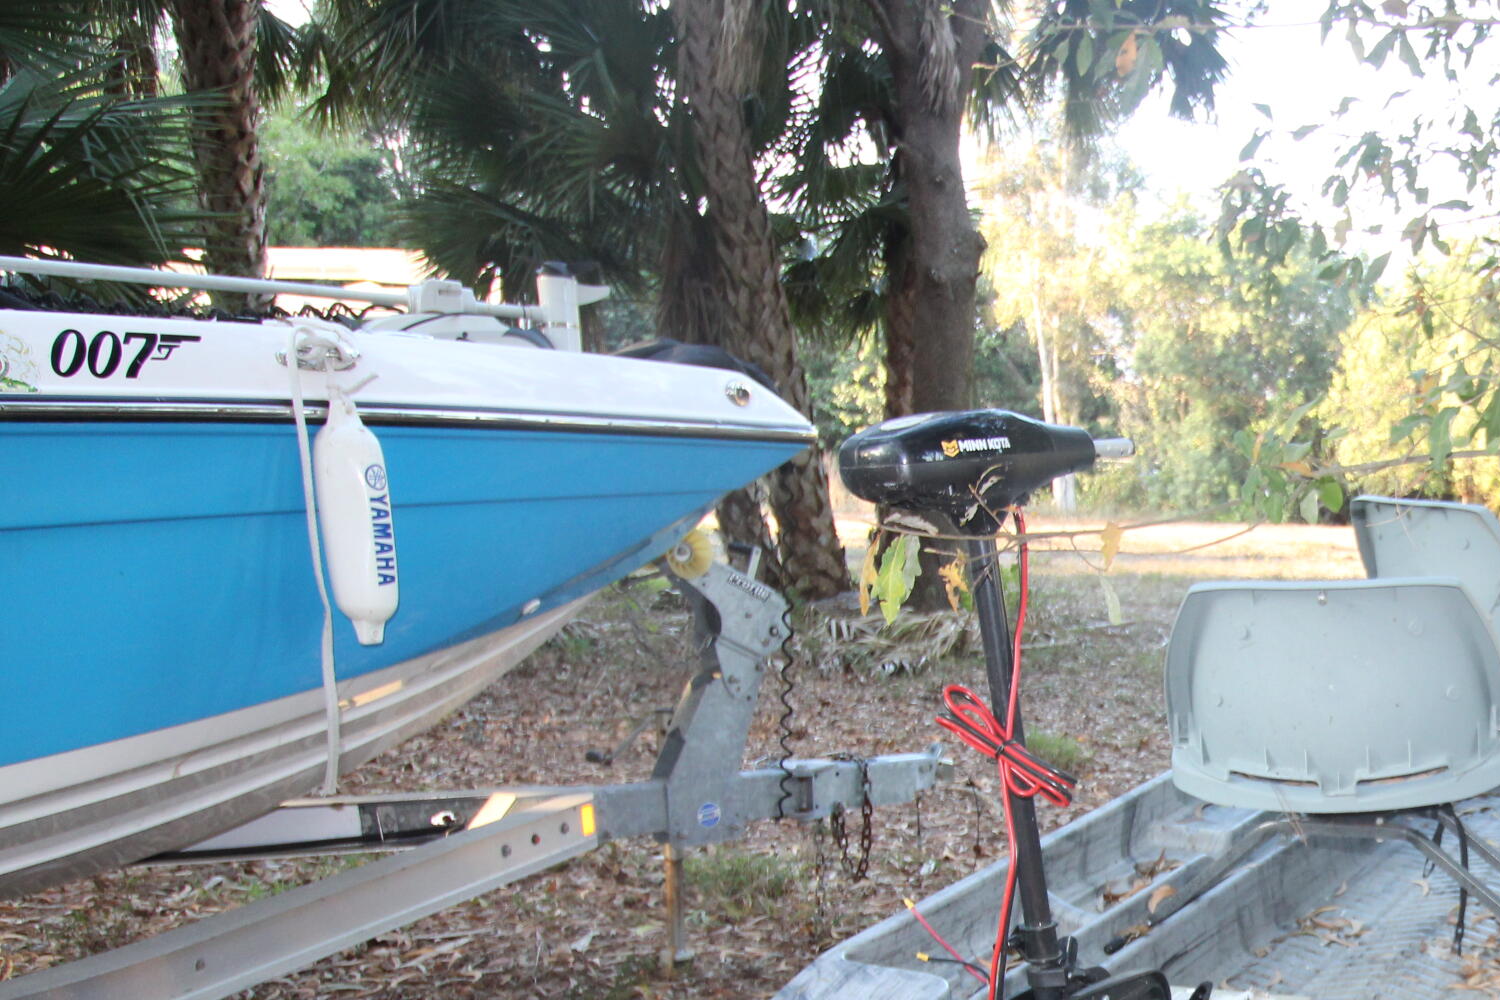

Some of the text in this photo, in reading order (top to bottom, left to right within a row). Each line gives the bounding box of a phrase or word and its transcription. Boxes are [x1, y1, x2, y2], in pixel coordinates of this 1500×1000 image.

[51, 329, 158, 379] 007
[958, 437, 1011, 452] MINN KOTA
[370, 494, 395, 586] YAMAHA
